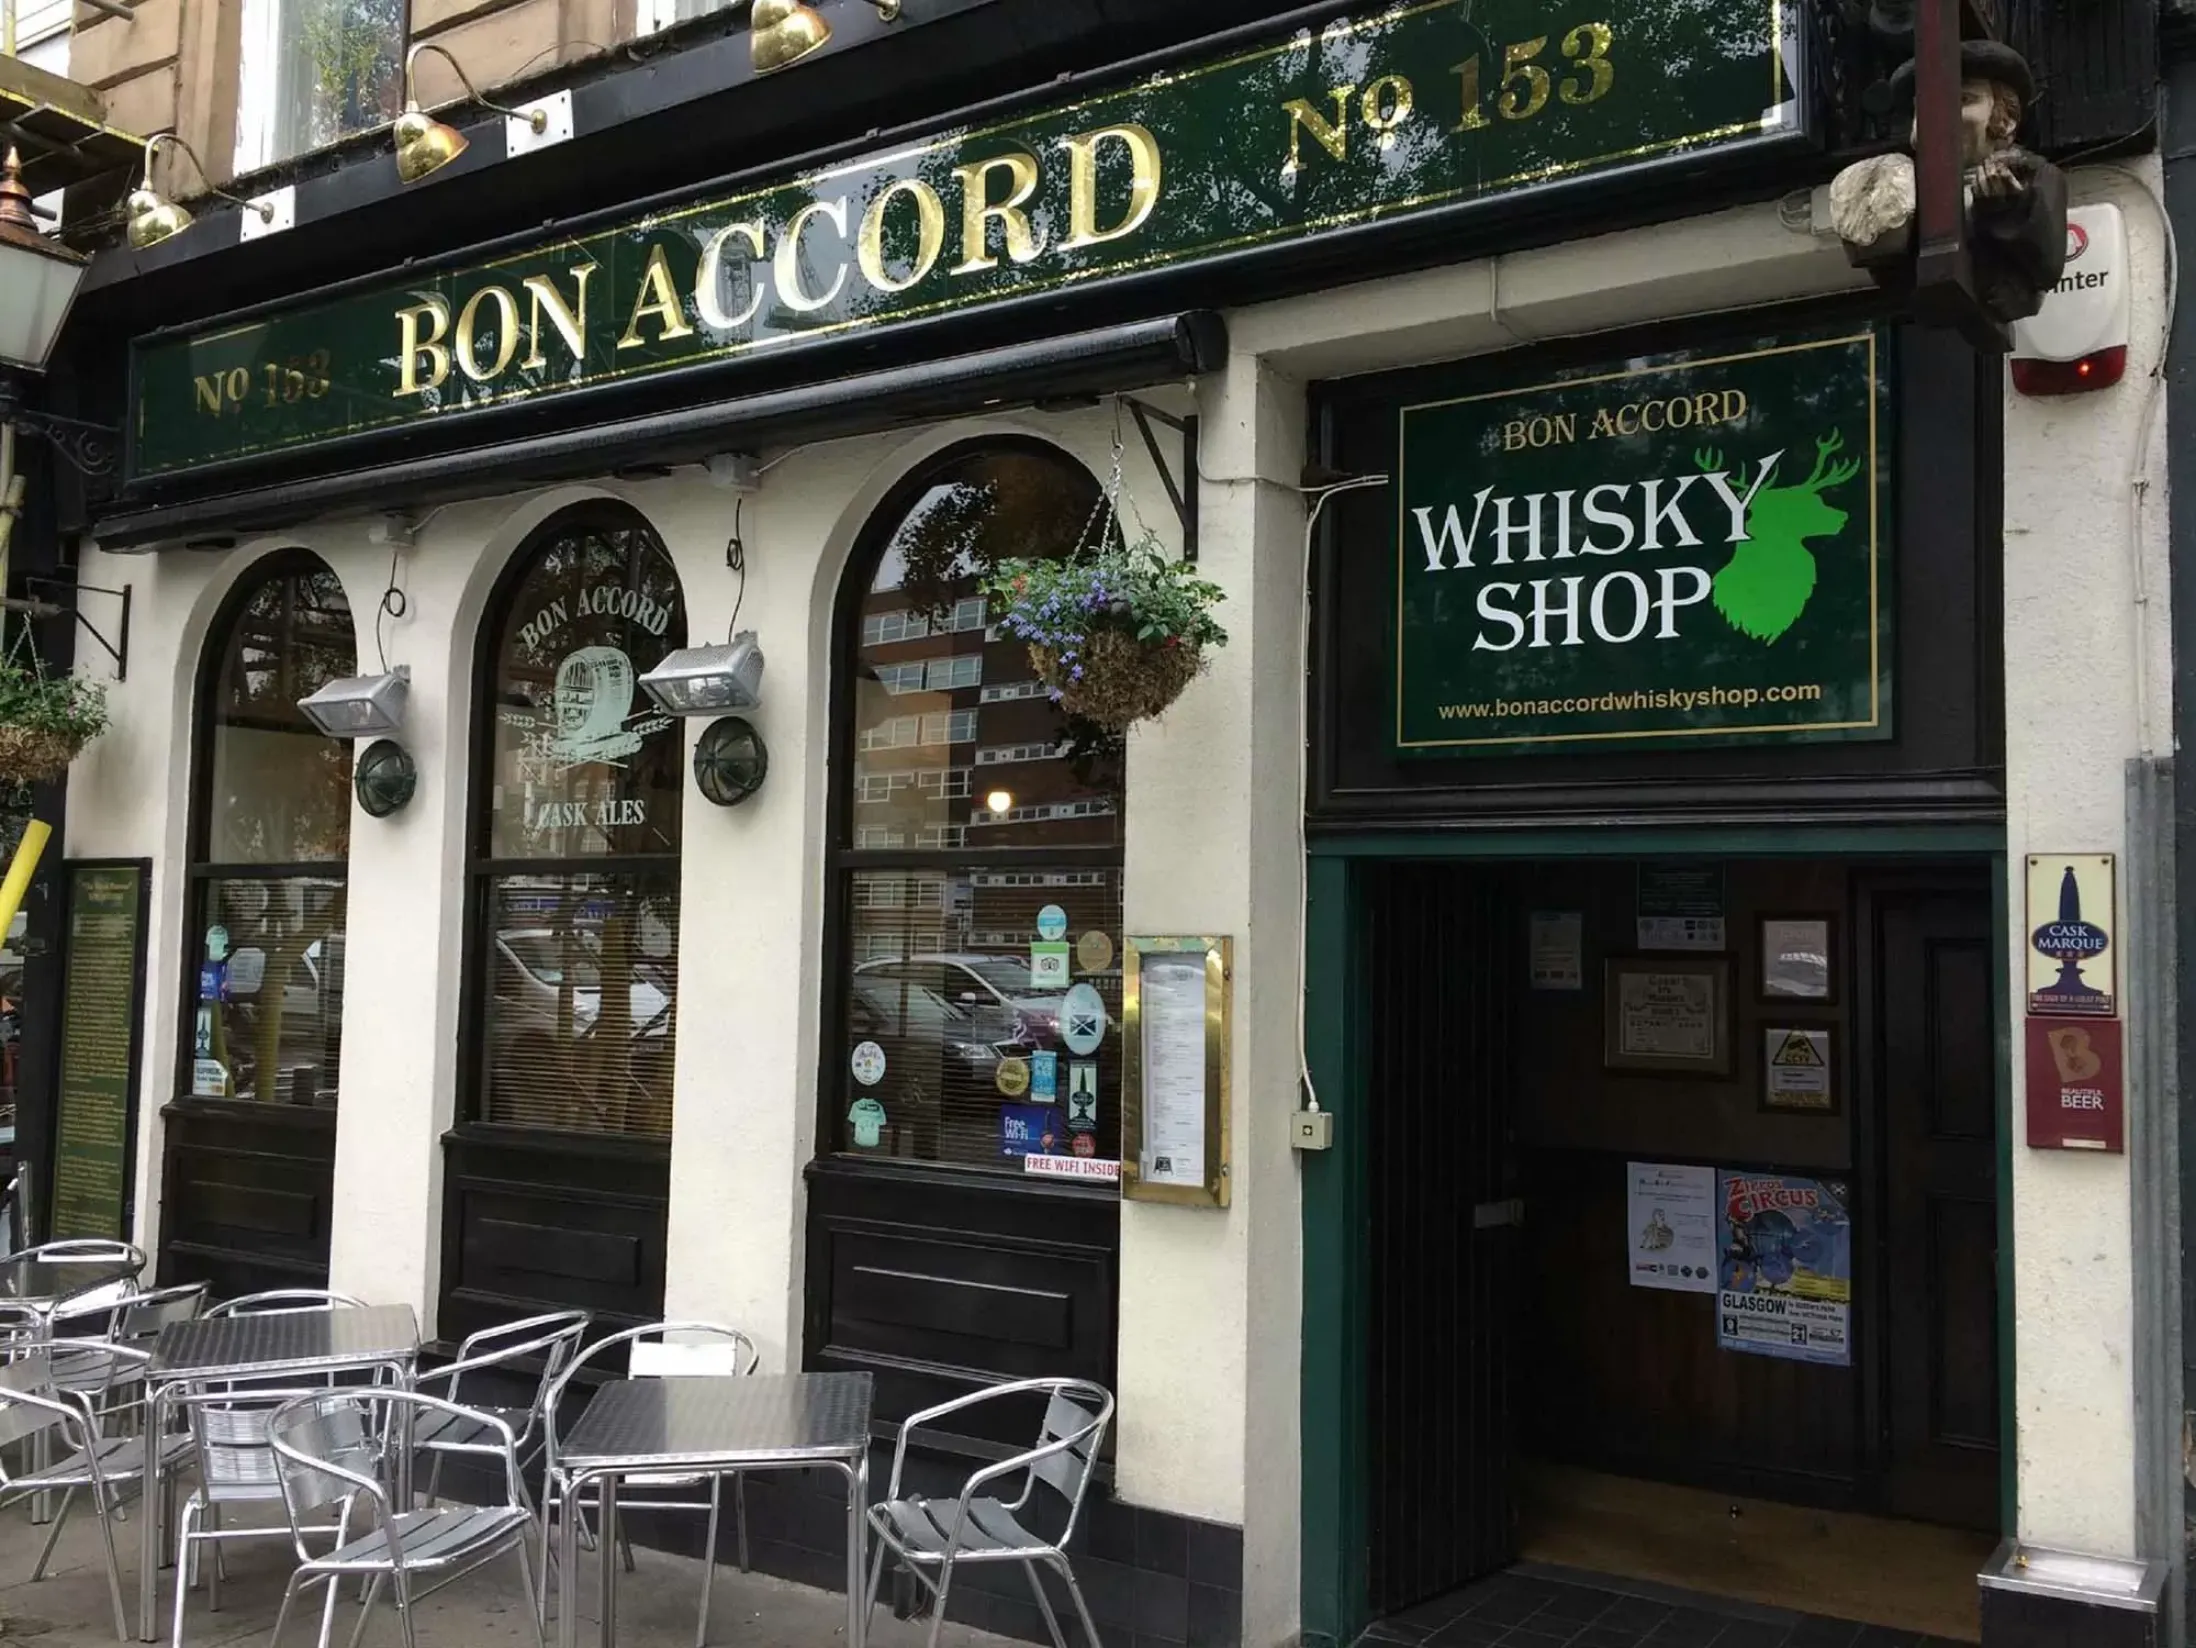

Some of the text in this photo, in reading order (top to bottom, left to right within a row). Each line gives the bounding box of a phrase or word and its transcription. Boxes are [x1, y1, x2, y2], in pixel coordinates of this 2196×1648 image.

[1449, 22, 1614, 135] 153
[392, 122, 1163, 399] BON ACCORD
[264, 348, 331, 409] 153
[1503, 388, 1748, 452] BON ACCORD
[1410, 448, 1785, 573] WHISKY
[519, 585, 670, 651] BON ACCORD
[1471, 567, 1712, 652] SHOP
[1438, 680, 1822, 721] www.bonaccordwhiskyshop.com
[540, 799, 646, 828] CASK ALES
[2038, 938, 2104, 950] MARQUE
[2049, 925, 2088, 937] CASK
[2061, 1096, 2104, 1110] BEER
[1004, 1116, 1025, 1128] Free
[1027, 1157, 1051, 1170] FREE
[1055, 1160, 1079, 1172] WIFI
[1727, 1188, 1818, 1221] CIRCUS
[1723, 1293, 1787, 1315] GLASGOW
[1793, 1328, 1805, 1340] 21
